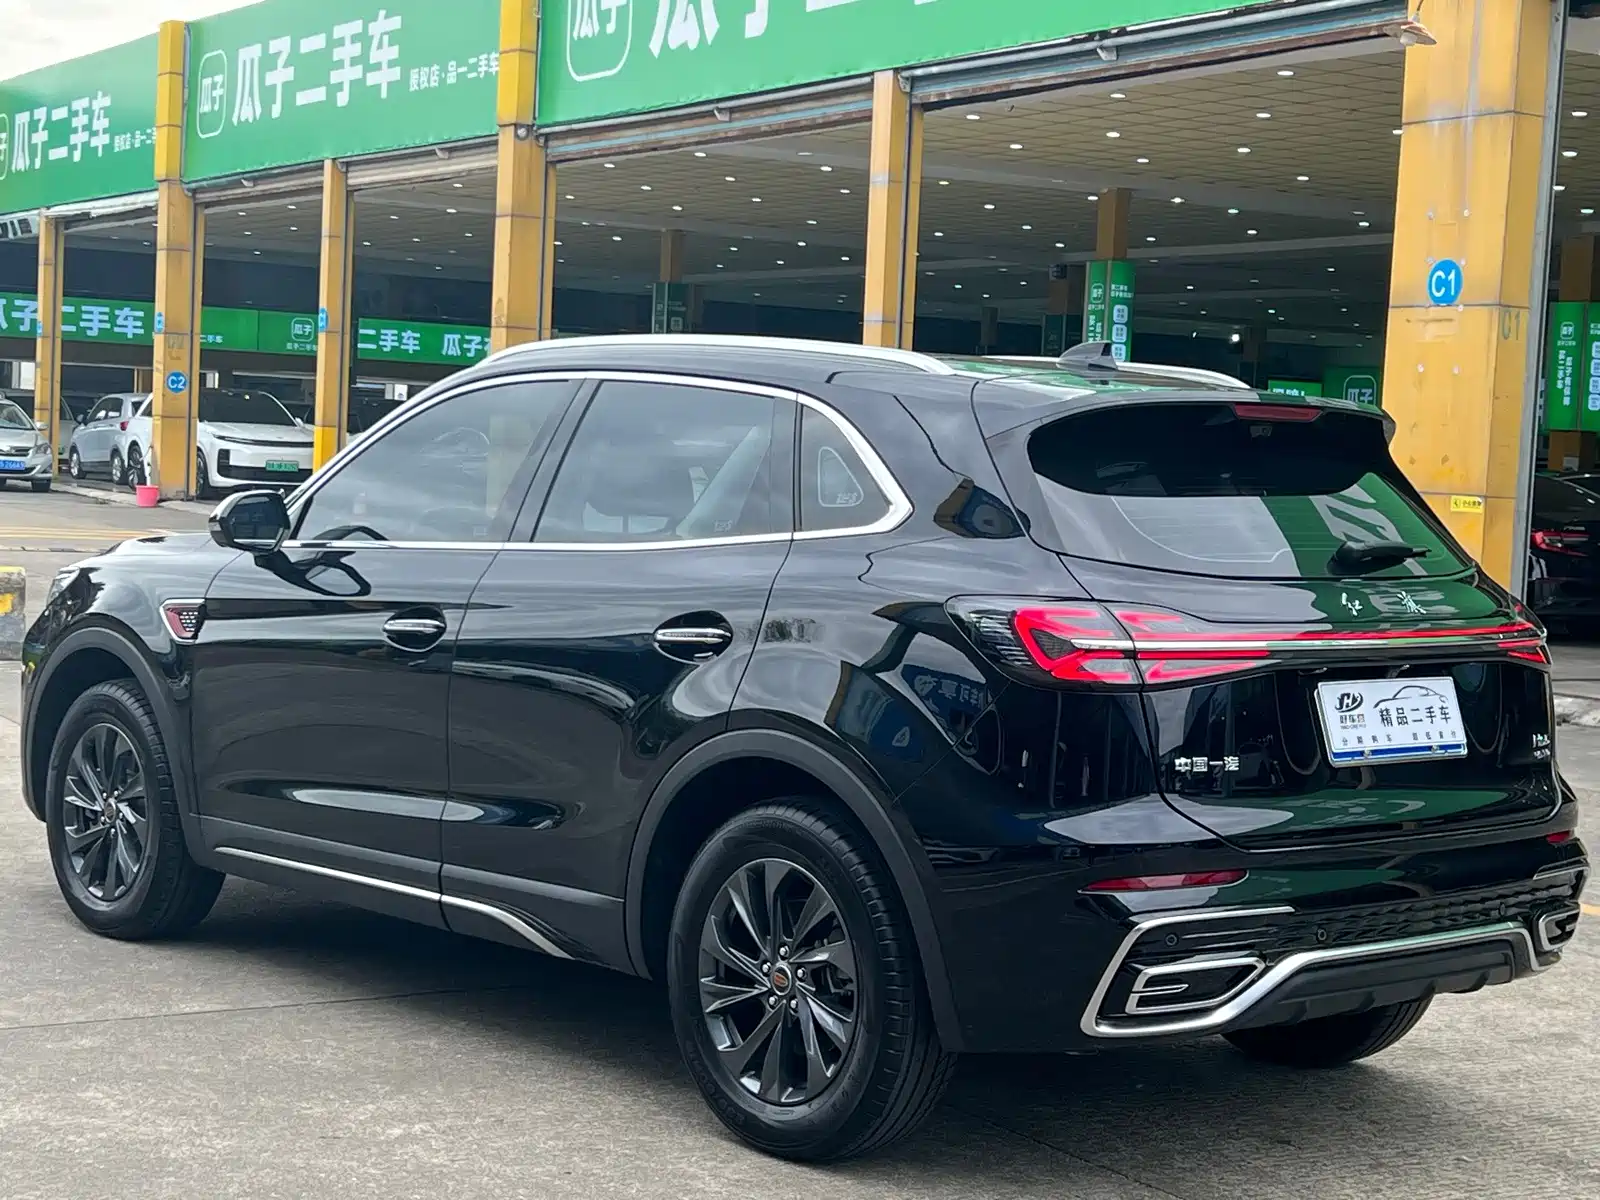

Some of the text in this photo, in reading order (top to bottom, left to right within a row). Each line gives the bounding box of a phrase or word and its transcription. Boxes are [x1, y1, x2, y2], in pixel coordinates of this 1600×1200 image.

[232, 9, 402, 126] 瓜子二手车
[200, 75, 224, 114] 瓜子
[12, 91, 111, 173] 瓜子二手车
[1431, 269, 1456, 297] C1
[357, 328, 421, 354] 二手车
[168, 375, 186, 389] C2
[1379, 705, 1451, 728] 精品二手车
[1174, 756, 1239, 772] 中国一汽
